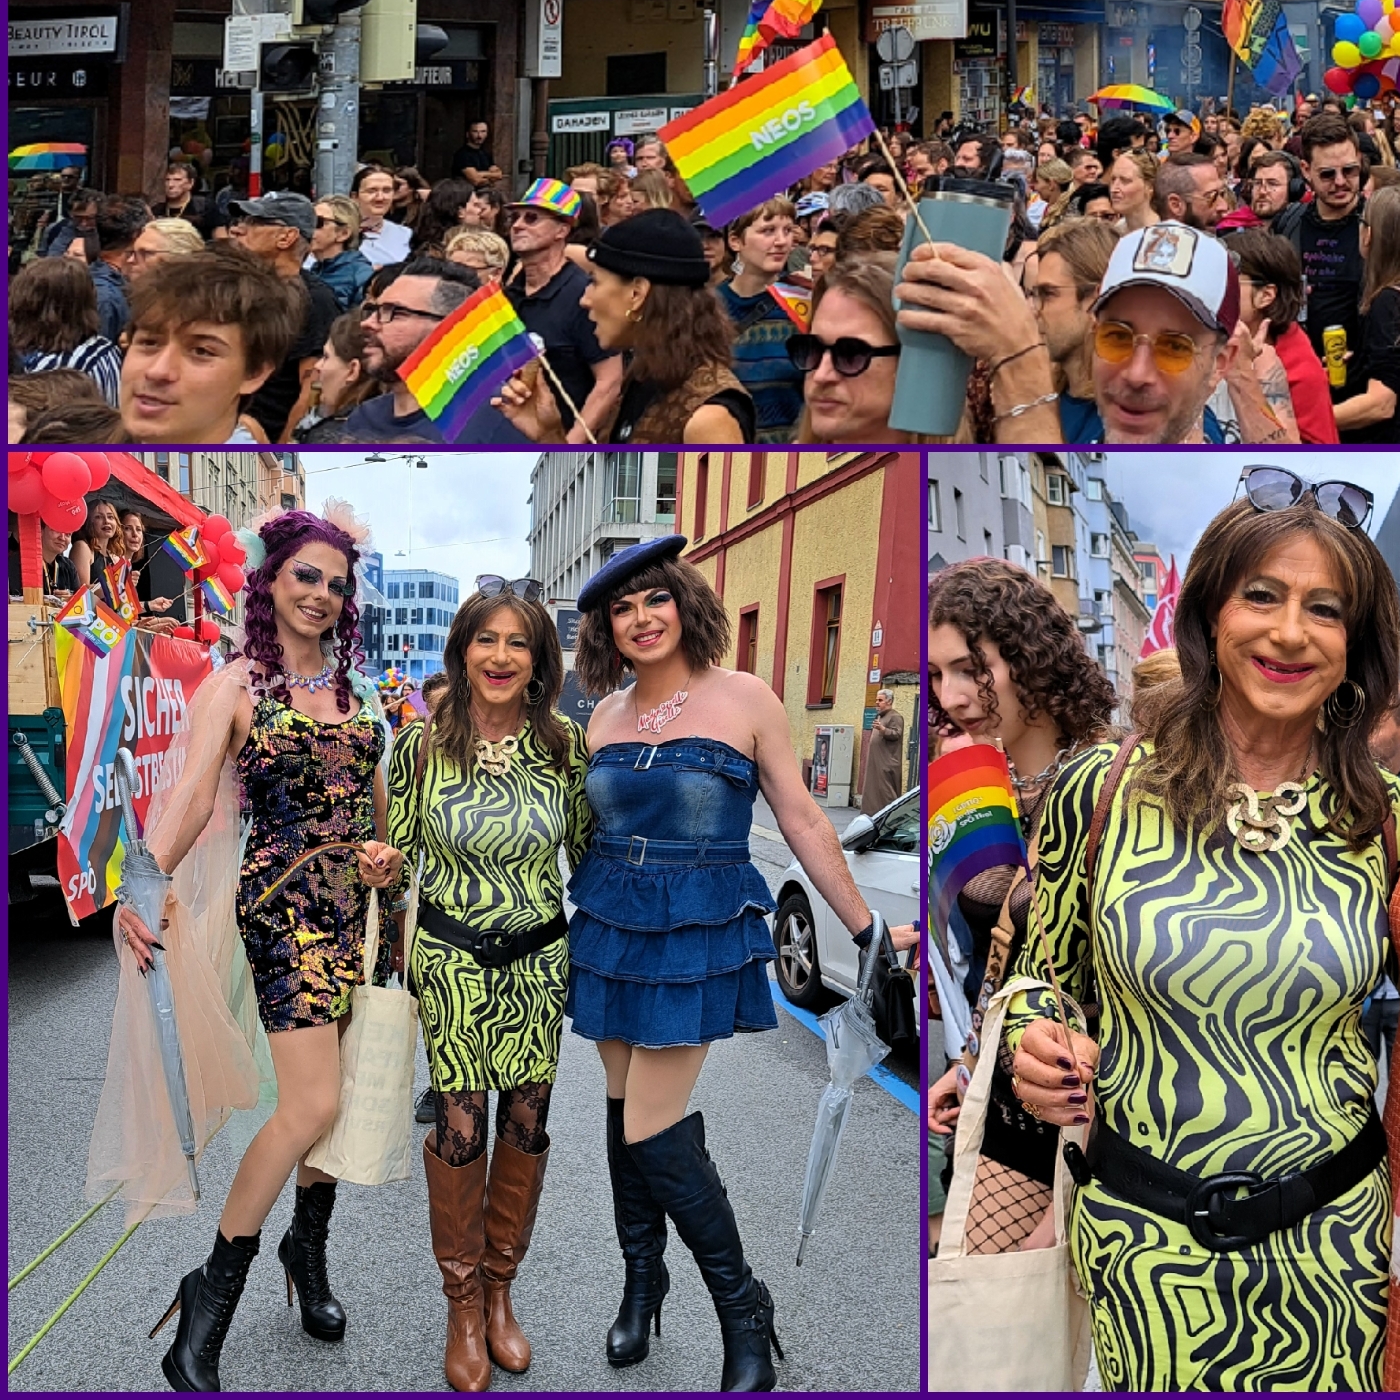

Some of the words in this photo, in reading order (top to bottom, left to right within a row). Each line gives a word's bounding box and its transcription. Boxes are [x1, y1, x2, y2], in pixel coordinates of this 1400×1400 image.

[749, 100, 816, 151] NEOS
[444, 343, 479, 385] NEOS
[80, 609, 120, 645] SPÖ
[120, 673, 190, 741] SICHER
[959, 814, 975, 828] SPÖ
[68, 861, 96, 903] SPÖ
